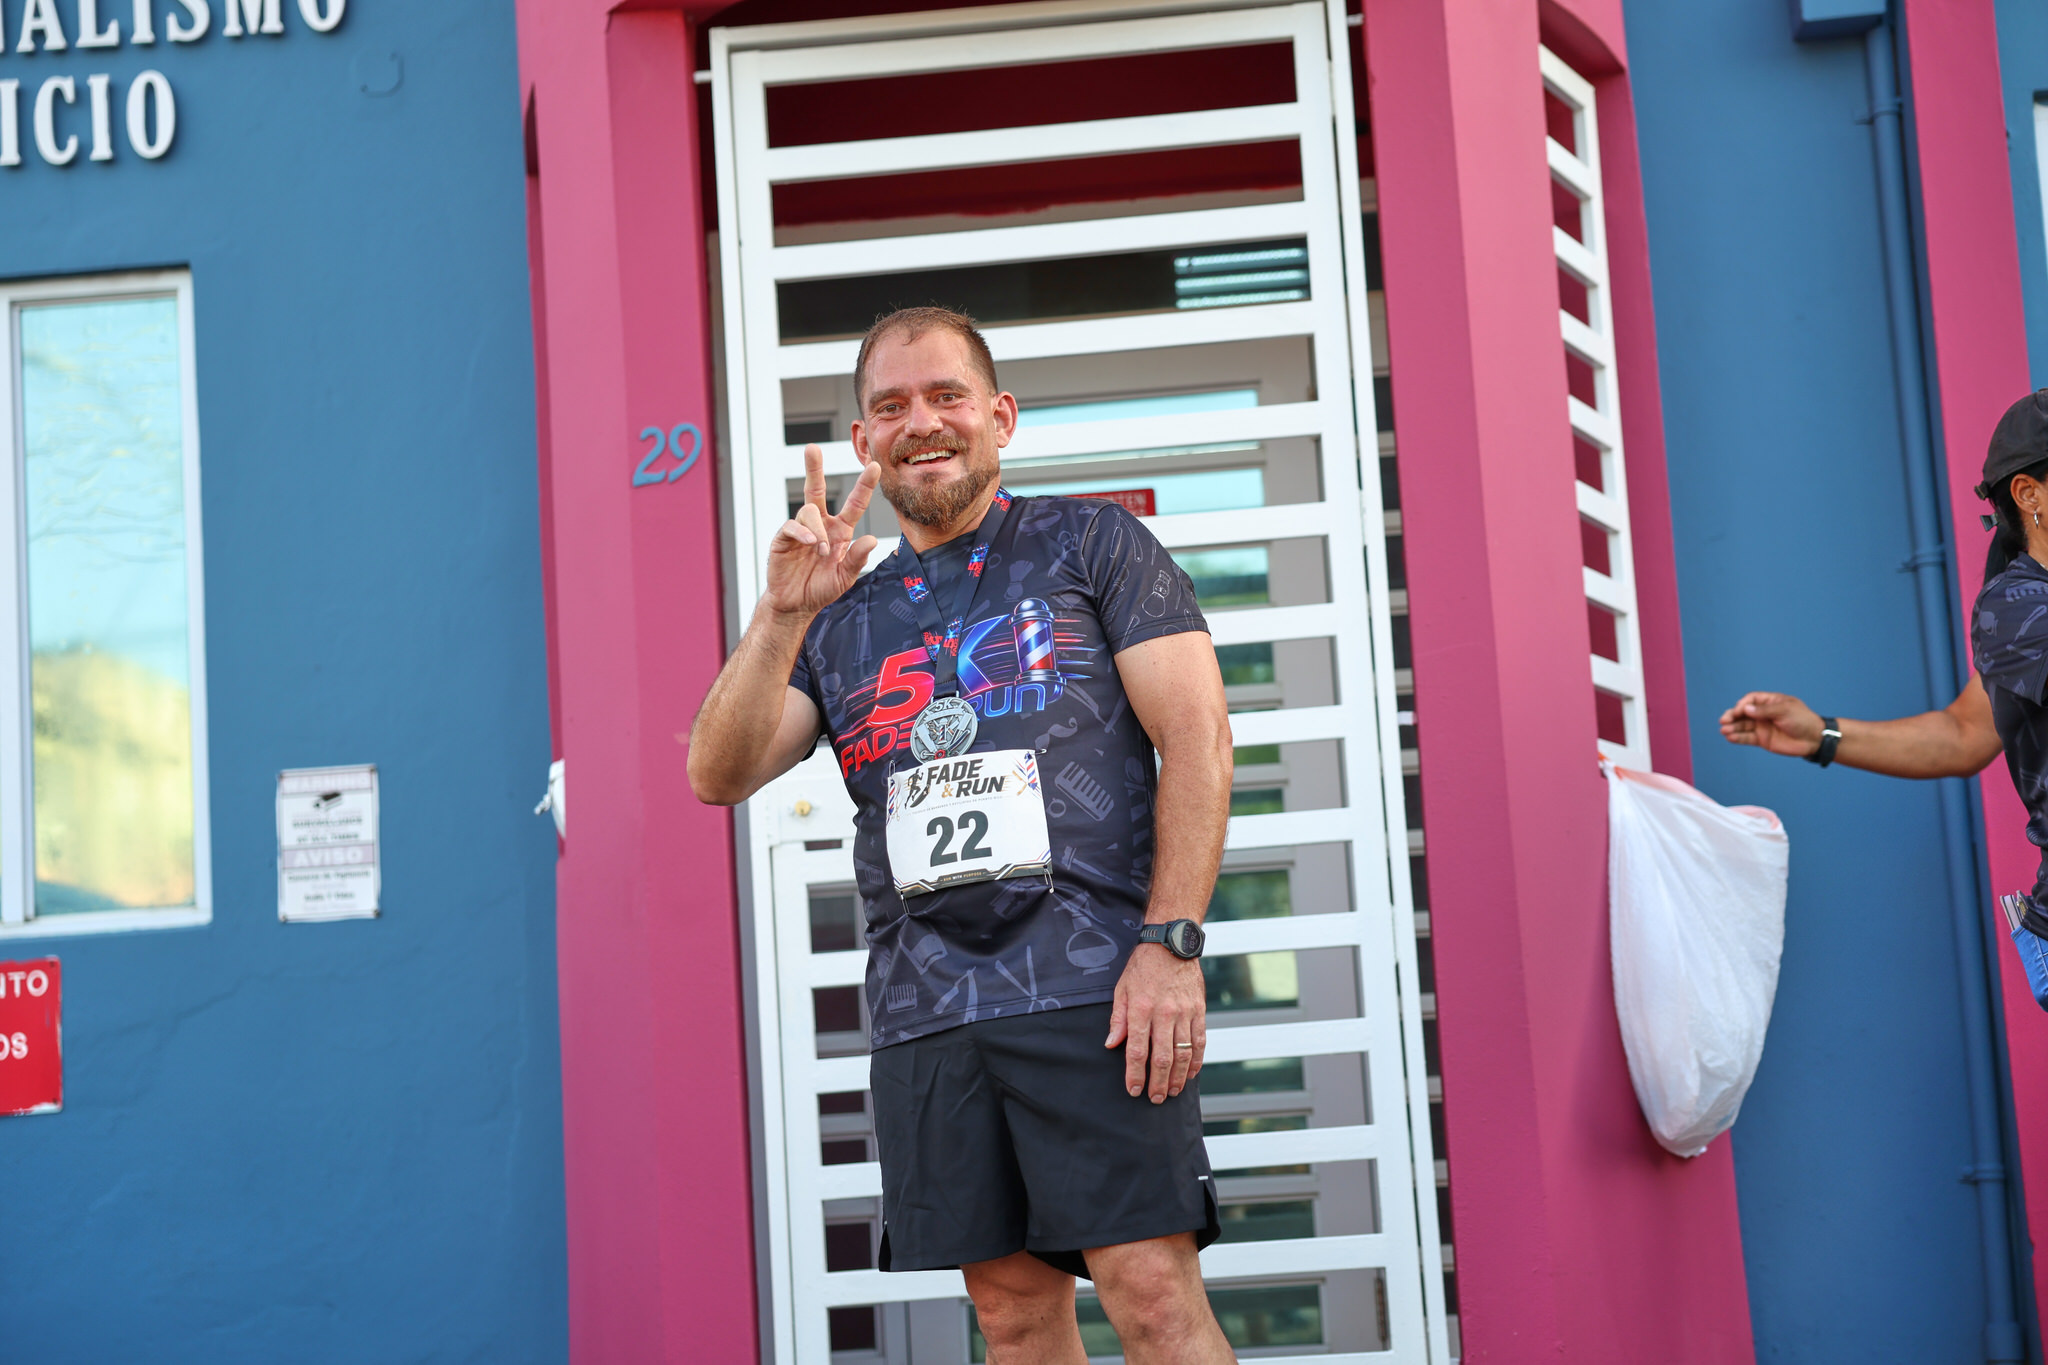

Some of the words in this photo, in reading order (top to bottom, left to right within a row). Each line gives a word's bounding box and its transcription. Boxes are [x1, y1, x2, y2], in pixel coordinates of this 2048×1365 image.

[0, 0, 347, 53] ALIS
[0, 69, 176, 166] ICIO
[632, 422, 703, 488] 29
[867, 613, 1011, 726] 5K
[935, 698, 953, 712] 5K
[839, 720, 914, 780] FADE
[926, 758, 984, 786] FADE
[941, 783, 954, 799] &
[955, 775, 1007, 798] RUN
[293, 845, 364, 867] AVISO
[926, 810, 993, 868] 22
